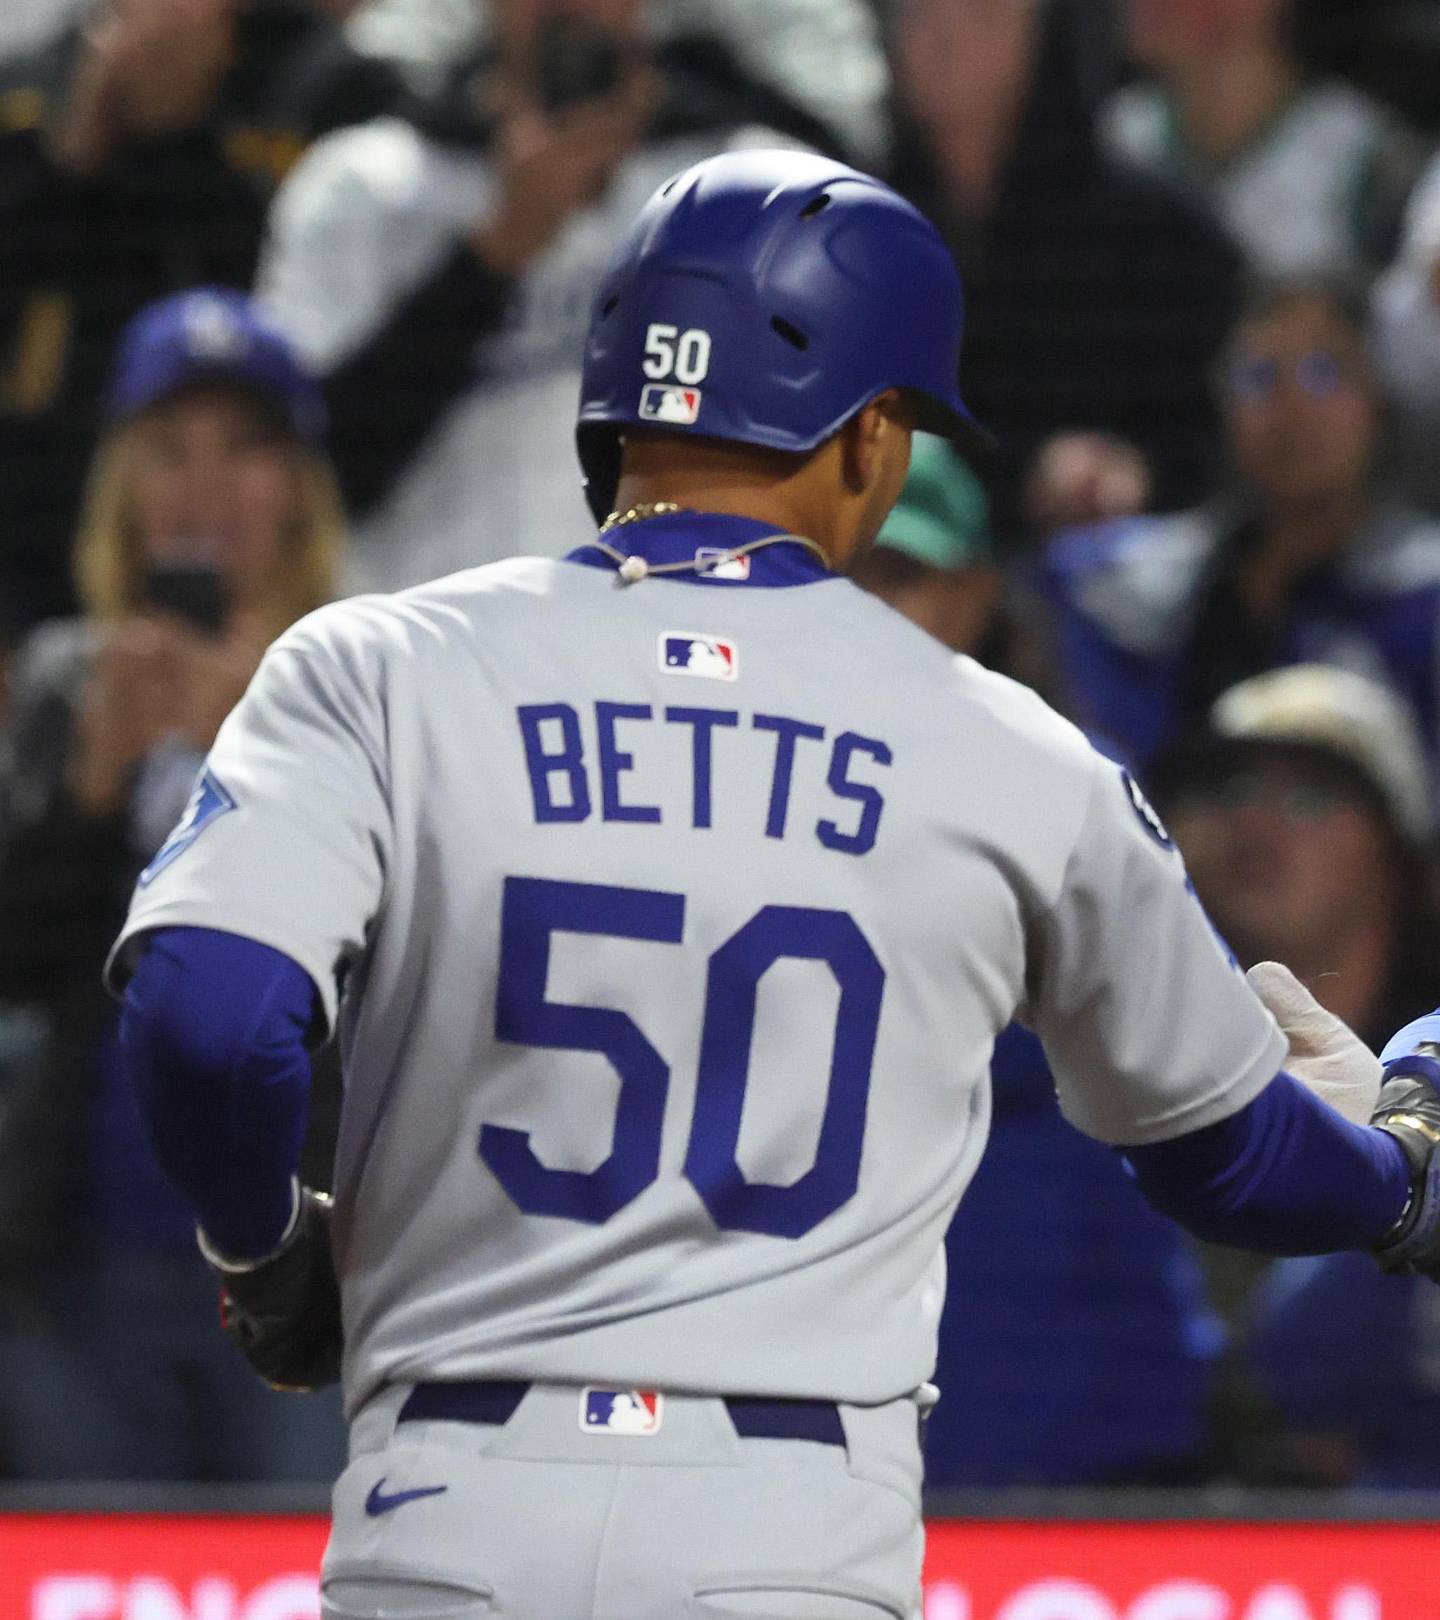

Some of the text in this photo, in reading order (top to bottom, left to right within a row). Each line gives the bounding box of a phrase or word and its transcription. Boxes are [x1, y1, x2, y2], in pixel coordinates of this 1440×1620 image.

[642, 323, 711, 385] 50
[516, 700, 894, 857] BETTS
[477, 875, 887, 1240] 50
